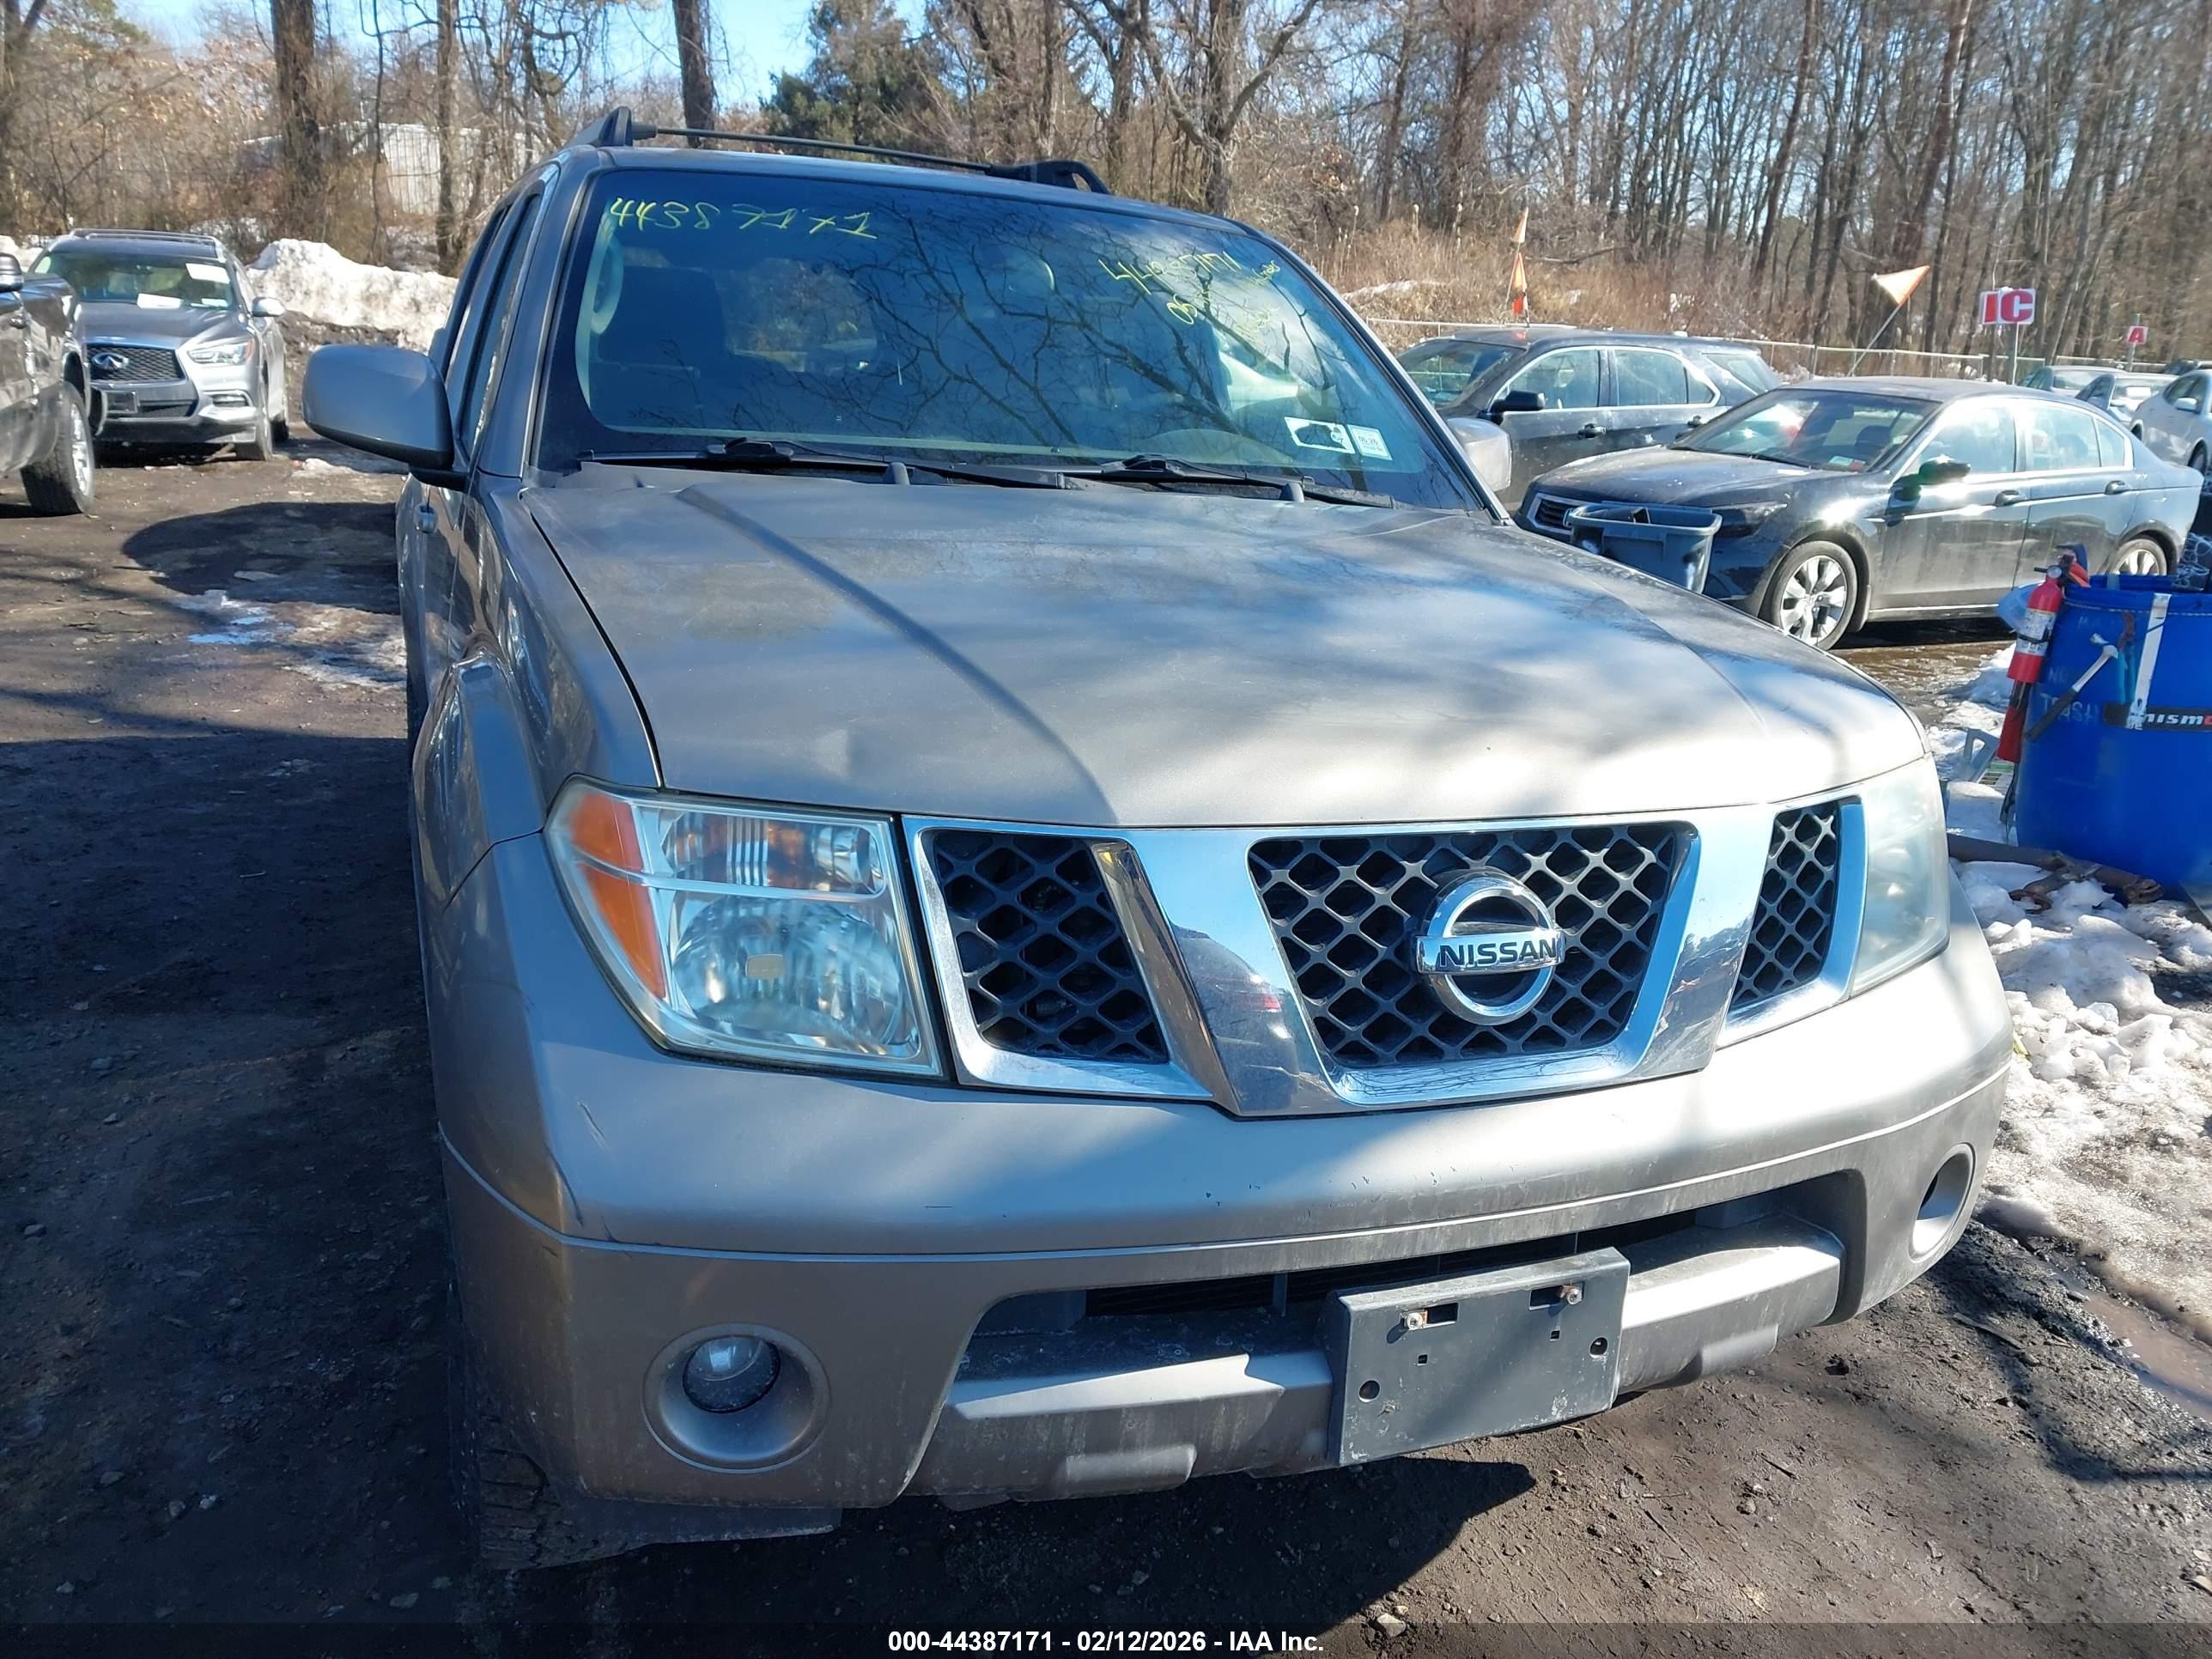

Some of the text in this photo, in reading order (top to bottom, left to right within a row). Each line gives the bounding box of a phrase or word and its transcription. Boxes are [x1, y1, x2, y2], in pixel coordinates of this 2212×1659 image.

[2128, 327, 2145, 343] A
[2039, 692, 2100, 723] TASH
[1438, 938, 1557, 967] NISSAN
